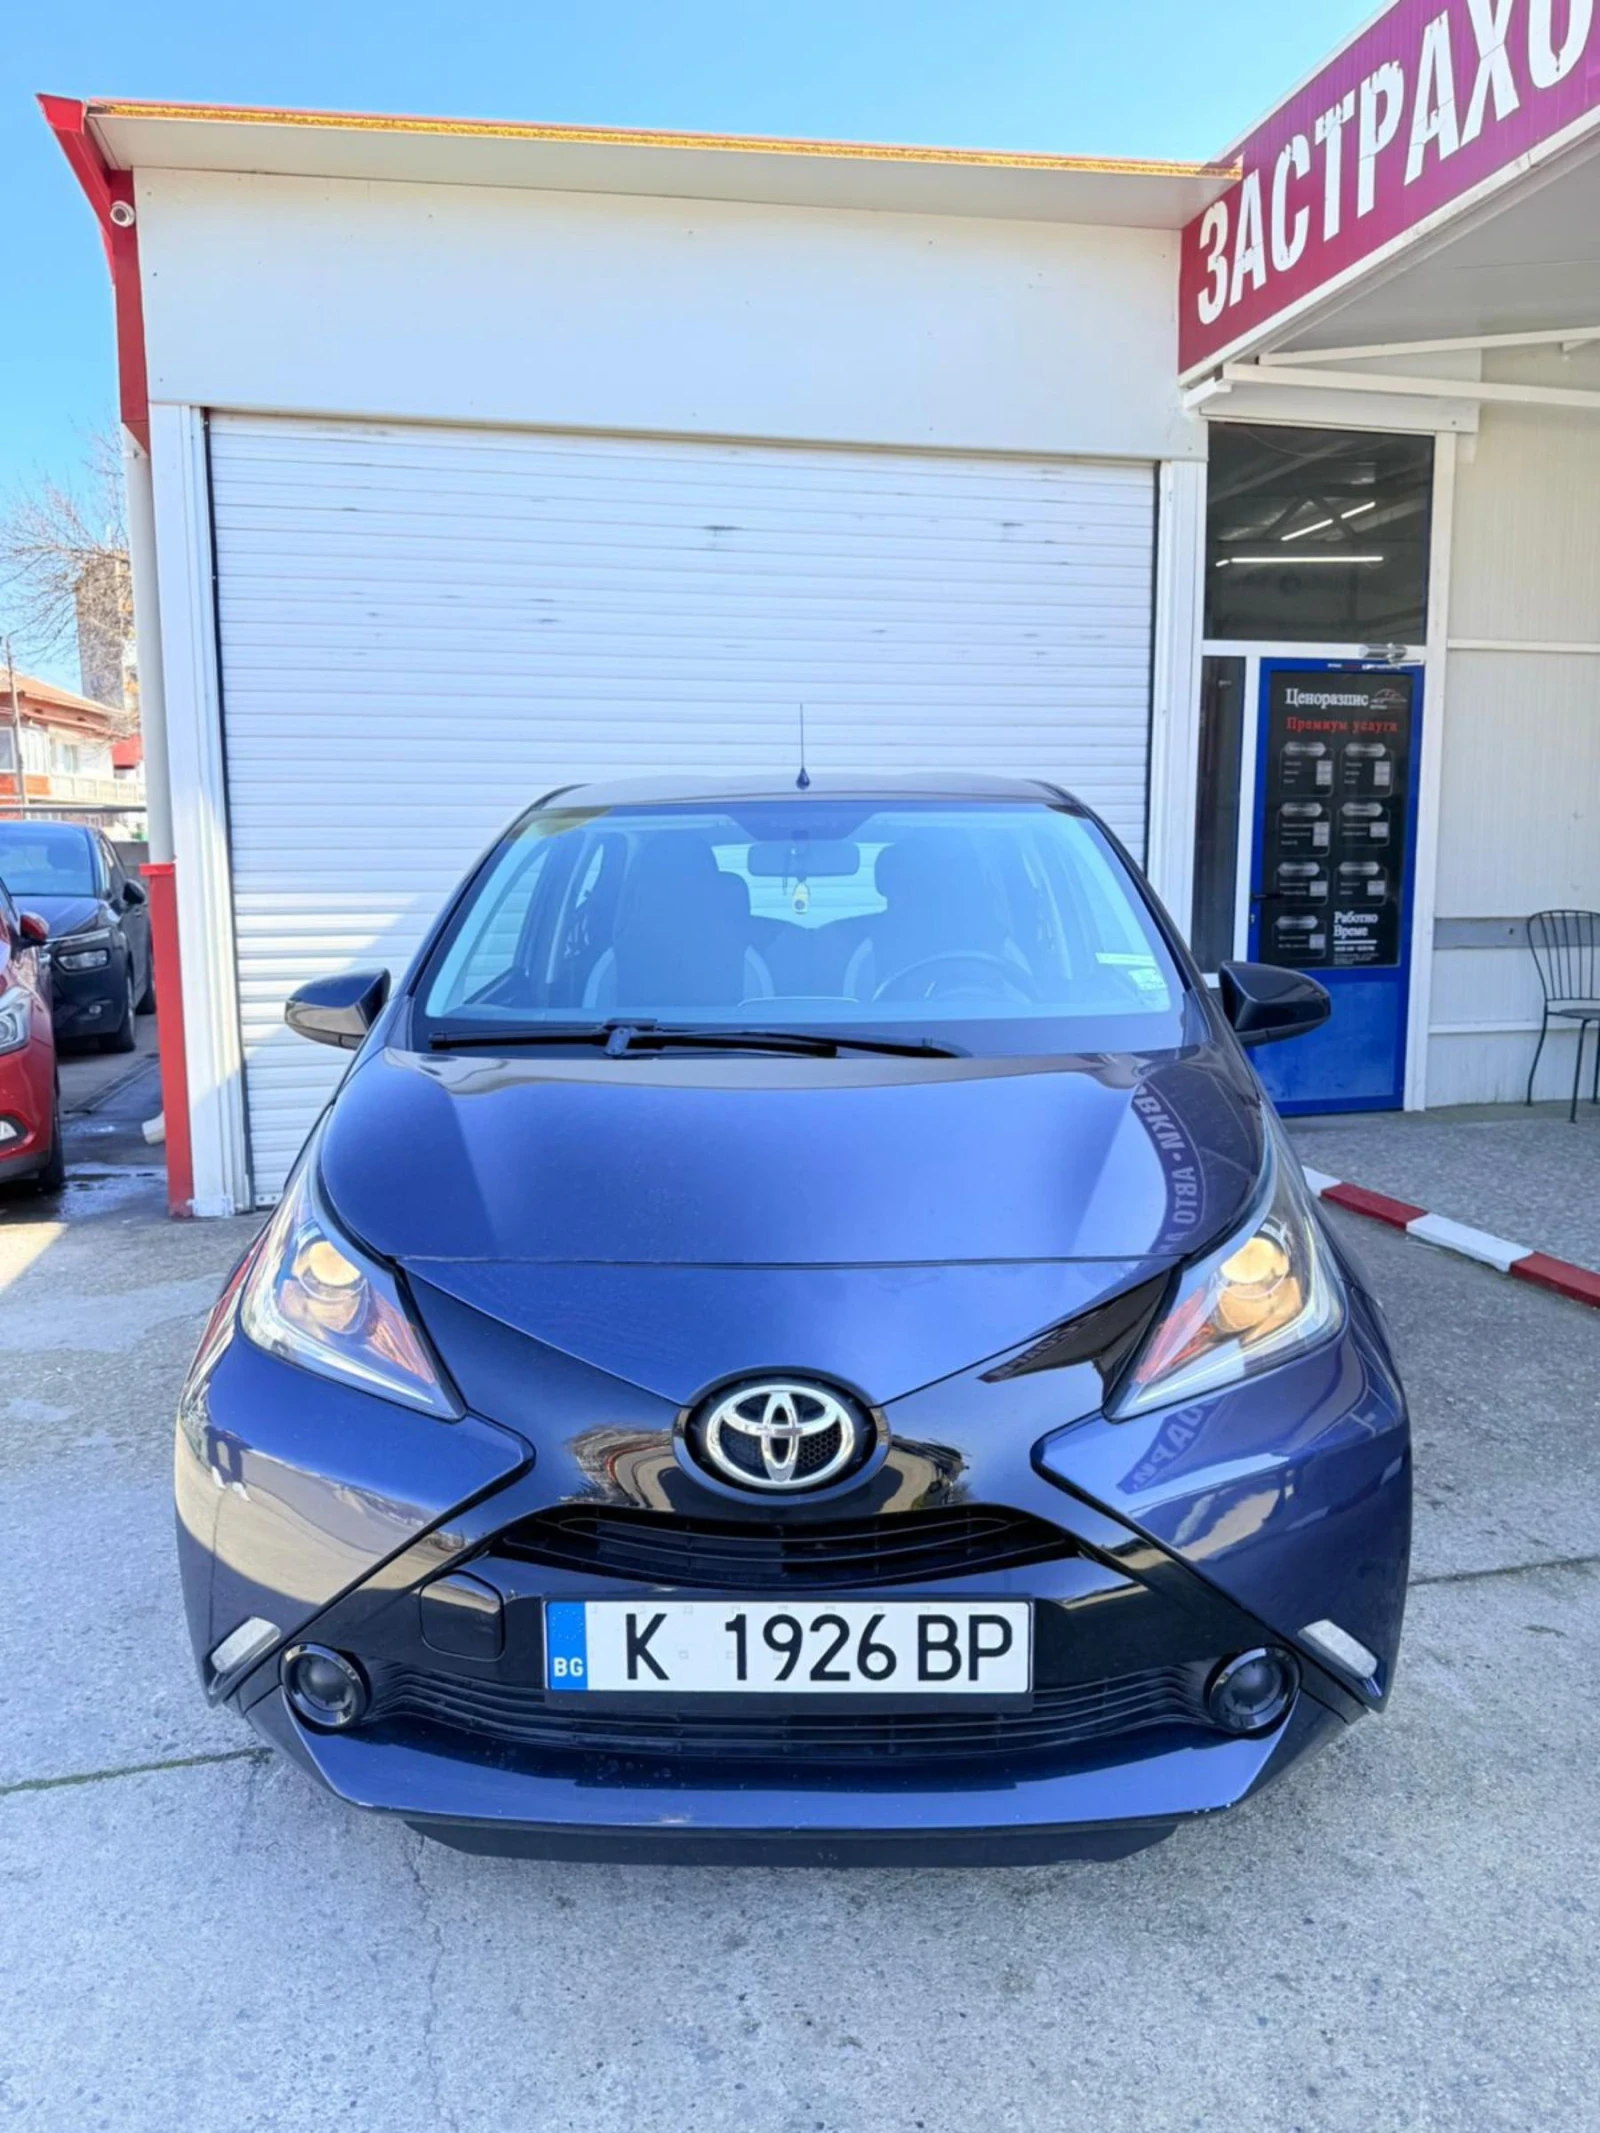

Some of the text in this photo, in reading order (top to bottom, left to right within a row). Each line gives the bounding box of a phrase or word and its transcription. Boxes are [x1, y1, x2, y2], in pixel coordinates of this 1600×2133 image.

[1285, 688, 1369, 710] Ценоразпис
[1286, 717, 1398, 733] Премиум услуги
[1333, 910, 1379, 924] Работно
[1333, 924, 1369, 939] Време
[625, 1612, 1013, 1682] K 1926 BP
[552, 1657, 584, 1678] BG
